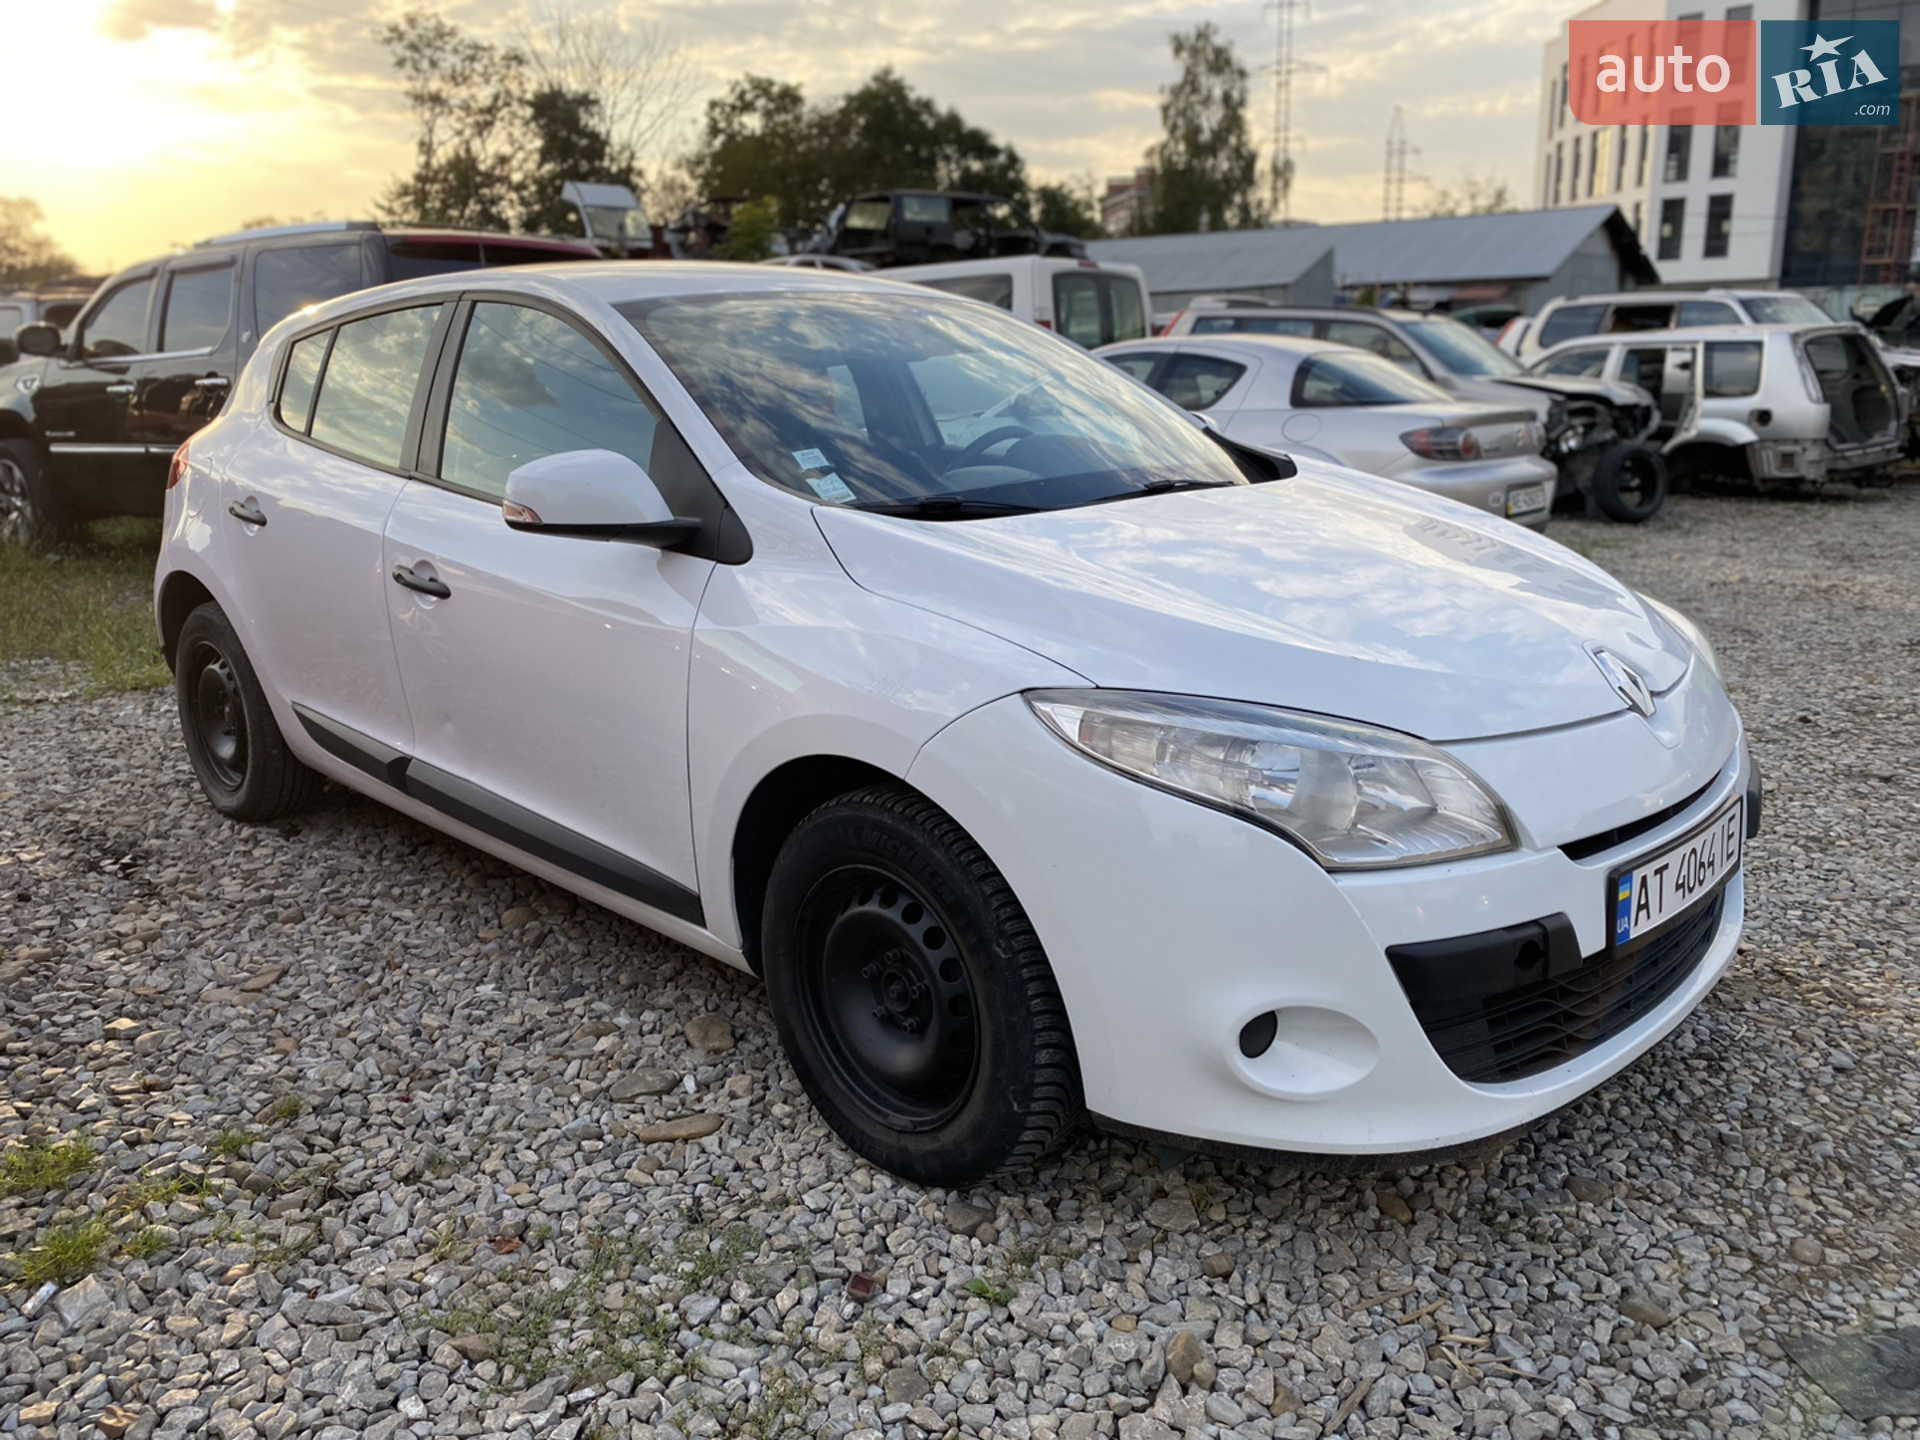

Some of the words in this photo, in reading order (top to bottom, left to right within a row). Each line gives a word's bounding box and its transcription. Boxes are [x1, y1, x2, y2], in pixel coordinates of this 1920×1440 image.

[861, 827, 960, 904] MICHELIN
[1634, 863, 1669, 928] AT
[1675, 832, 1716, 900] 4064
[1720, 813, 1737, 869] IE
[1616, 918, 1630, 934] UA
